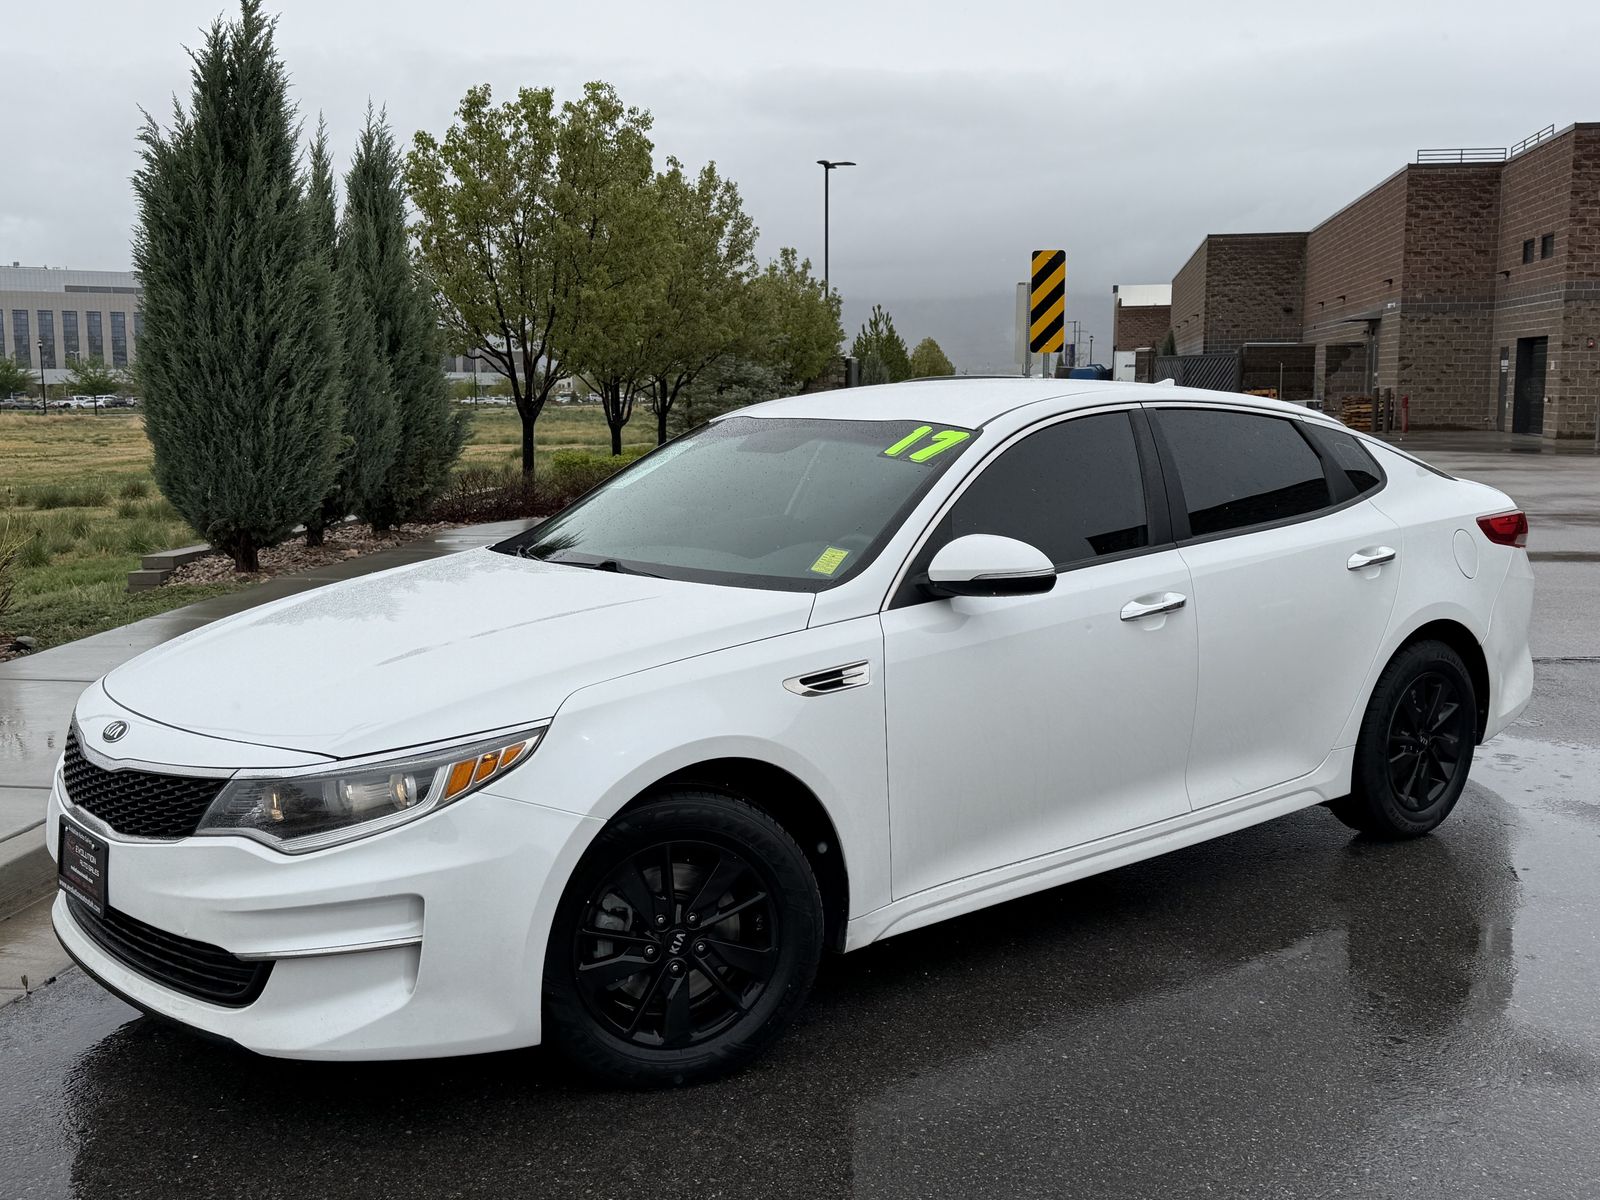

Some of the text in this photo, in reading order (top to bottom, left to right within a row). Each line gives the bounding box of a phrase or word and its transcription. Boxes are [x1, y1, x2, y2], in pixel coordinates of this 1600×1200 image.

[884, 425, 971, 463] 17
[103, 722, 125, 739] KIA
[668, 933, 686, 955] KIA
